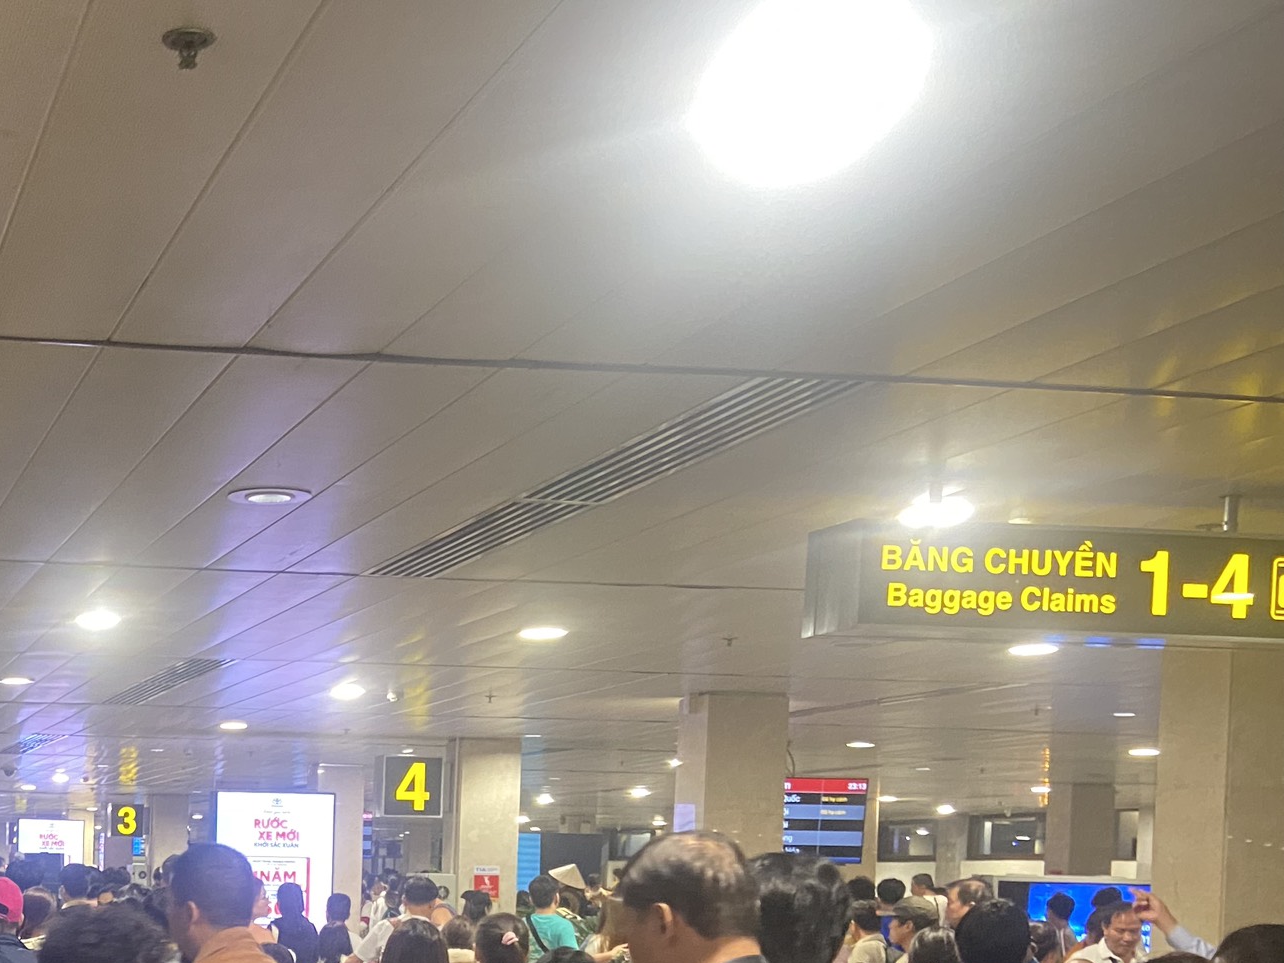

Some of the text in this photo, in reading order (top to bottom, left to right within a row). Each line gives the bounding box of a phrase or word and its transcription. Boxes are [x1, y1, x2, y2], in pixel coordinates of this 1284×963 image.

[881, 538, 1117, 578] BĂNG CHUYỀN
[887, 582, 1117, 616] Baggage Claims
[1140, 550, 1255, 619] 1-4
[395, 762, 430, 811] 4
[117, 806, 137, 835] 3
[254, 816, 288, 829] RƯỚC
[258, 828, 299, 842] XE MỚI
[260, 867, 296, 883] NĂM
